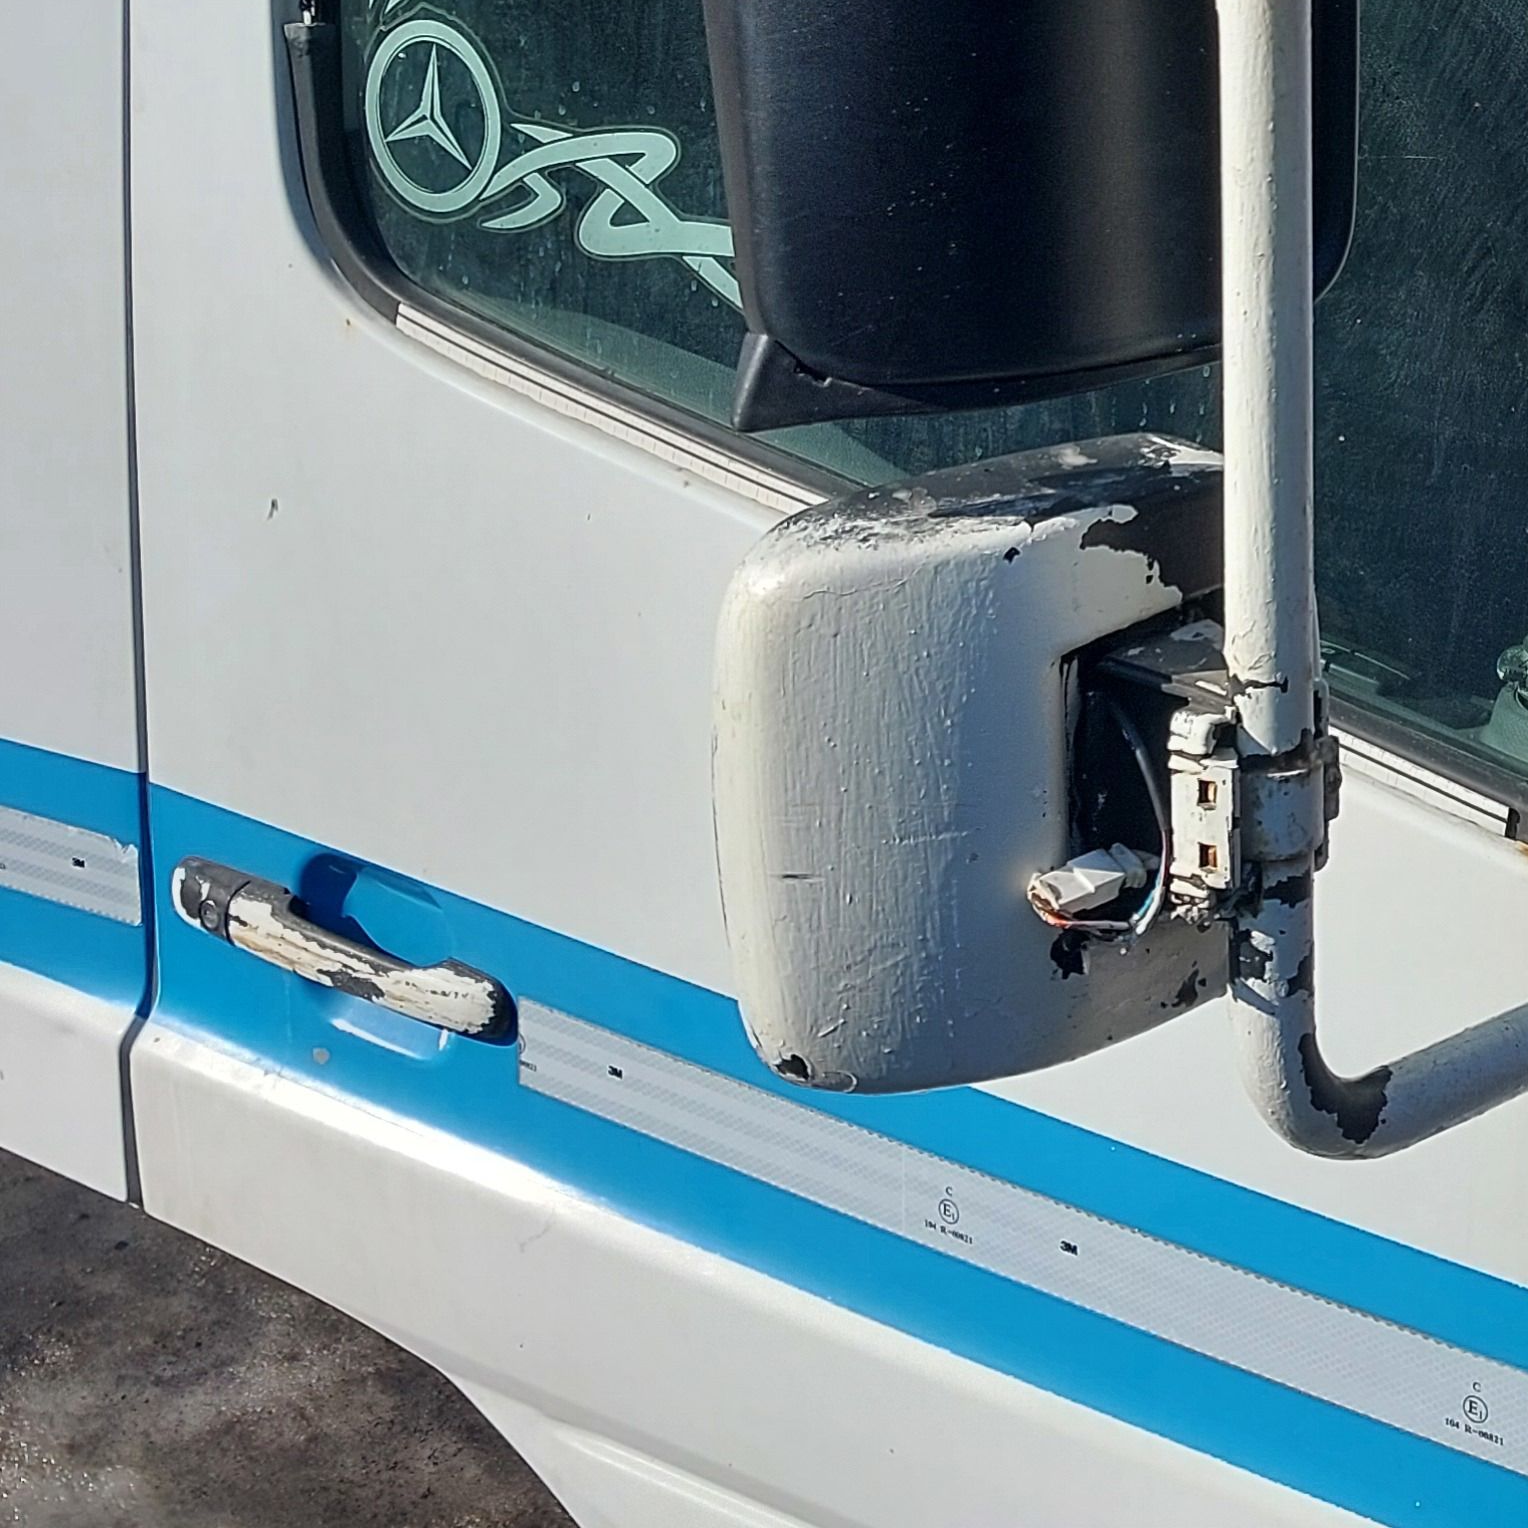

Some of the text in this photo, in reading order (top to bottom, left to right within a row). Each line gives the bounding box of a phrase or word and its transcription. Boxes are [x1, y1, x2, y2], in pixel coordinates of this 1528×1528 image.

[607, 1065, 623, 1080] 3M
[946, 1186, 953, 1197] C
[1060, 1240, 1079, 1256] 3M
[1472, 1382, 1482, 1392] C
